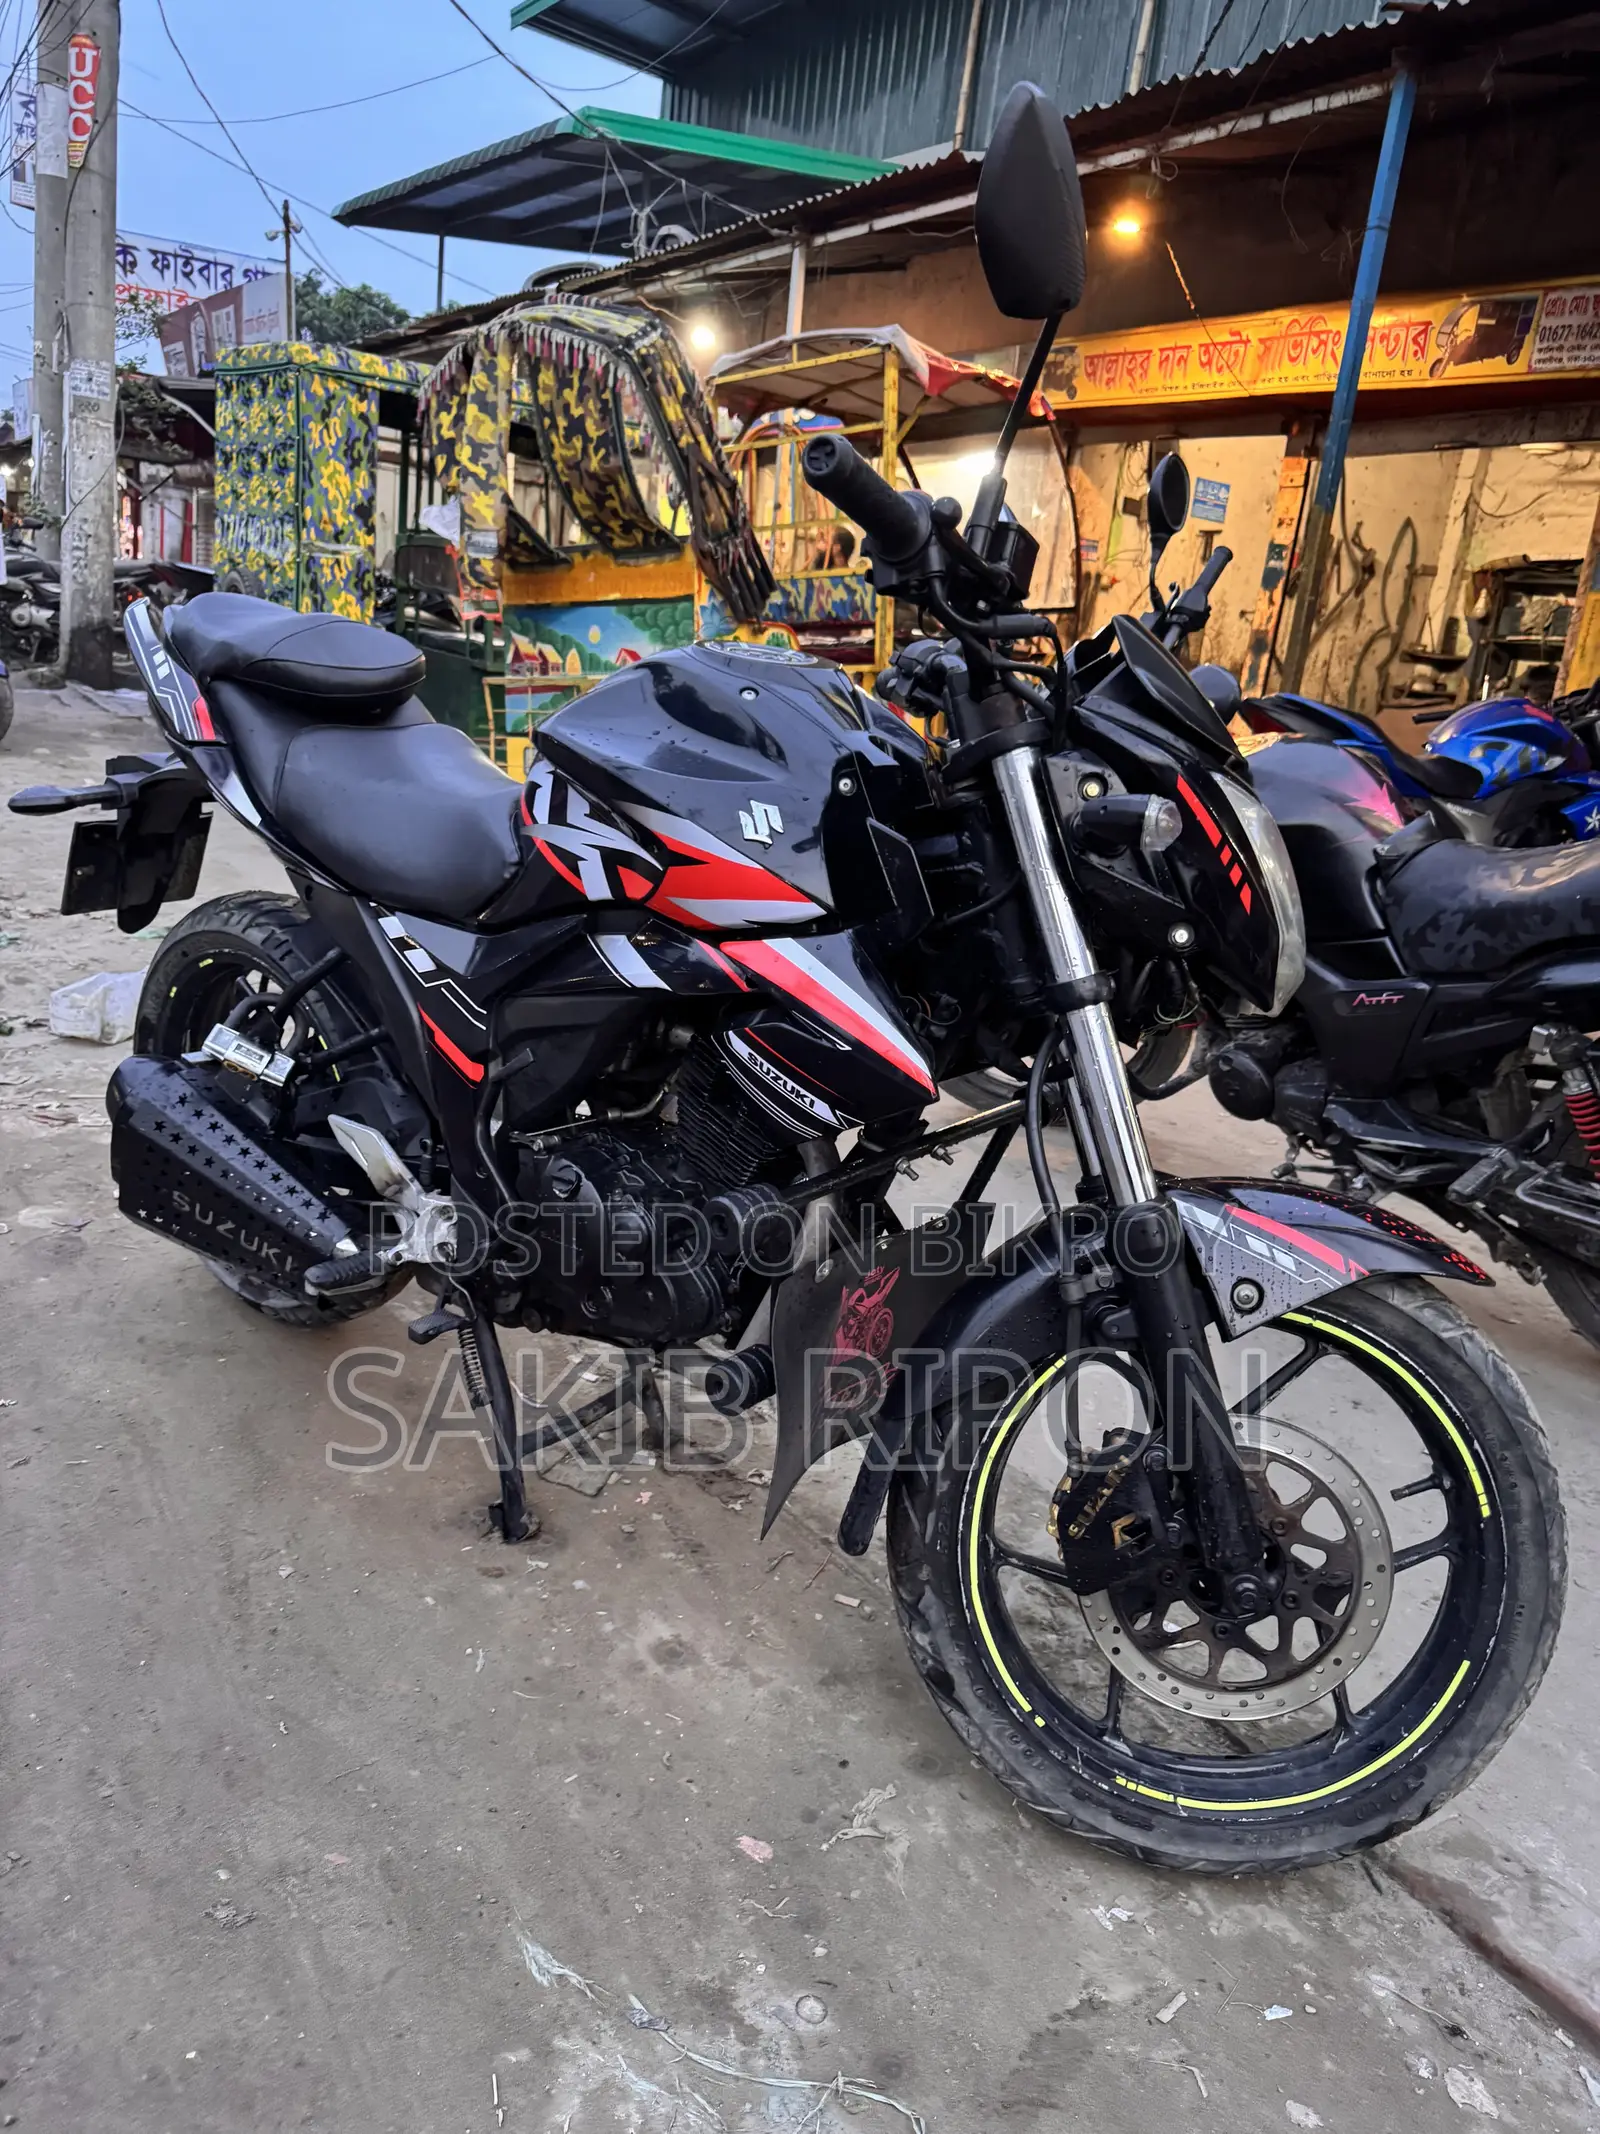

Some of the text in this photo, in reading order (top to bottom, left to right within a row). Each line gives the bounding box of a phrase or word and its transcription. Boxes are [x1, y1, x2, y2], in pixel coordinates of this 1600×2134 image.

[69, 47, 97, 142] UCC
[1158, 342, 1192, 381] দান
[1198, 329, 1251, 374] অটো
[747, 1051, 816, 1110] SUZUKI
[172, 1190, 293, 1273] SUZUKI
